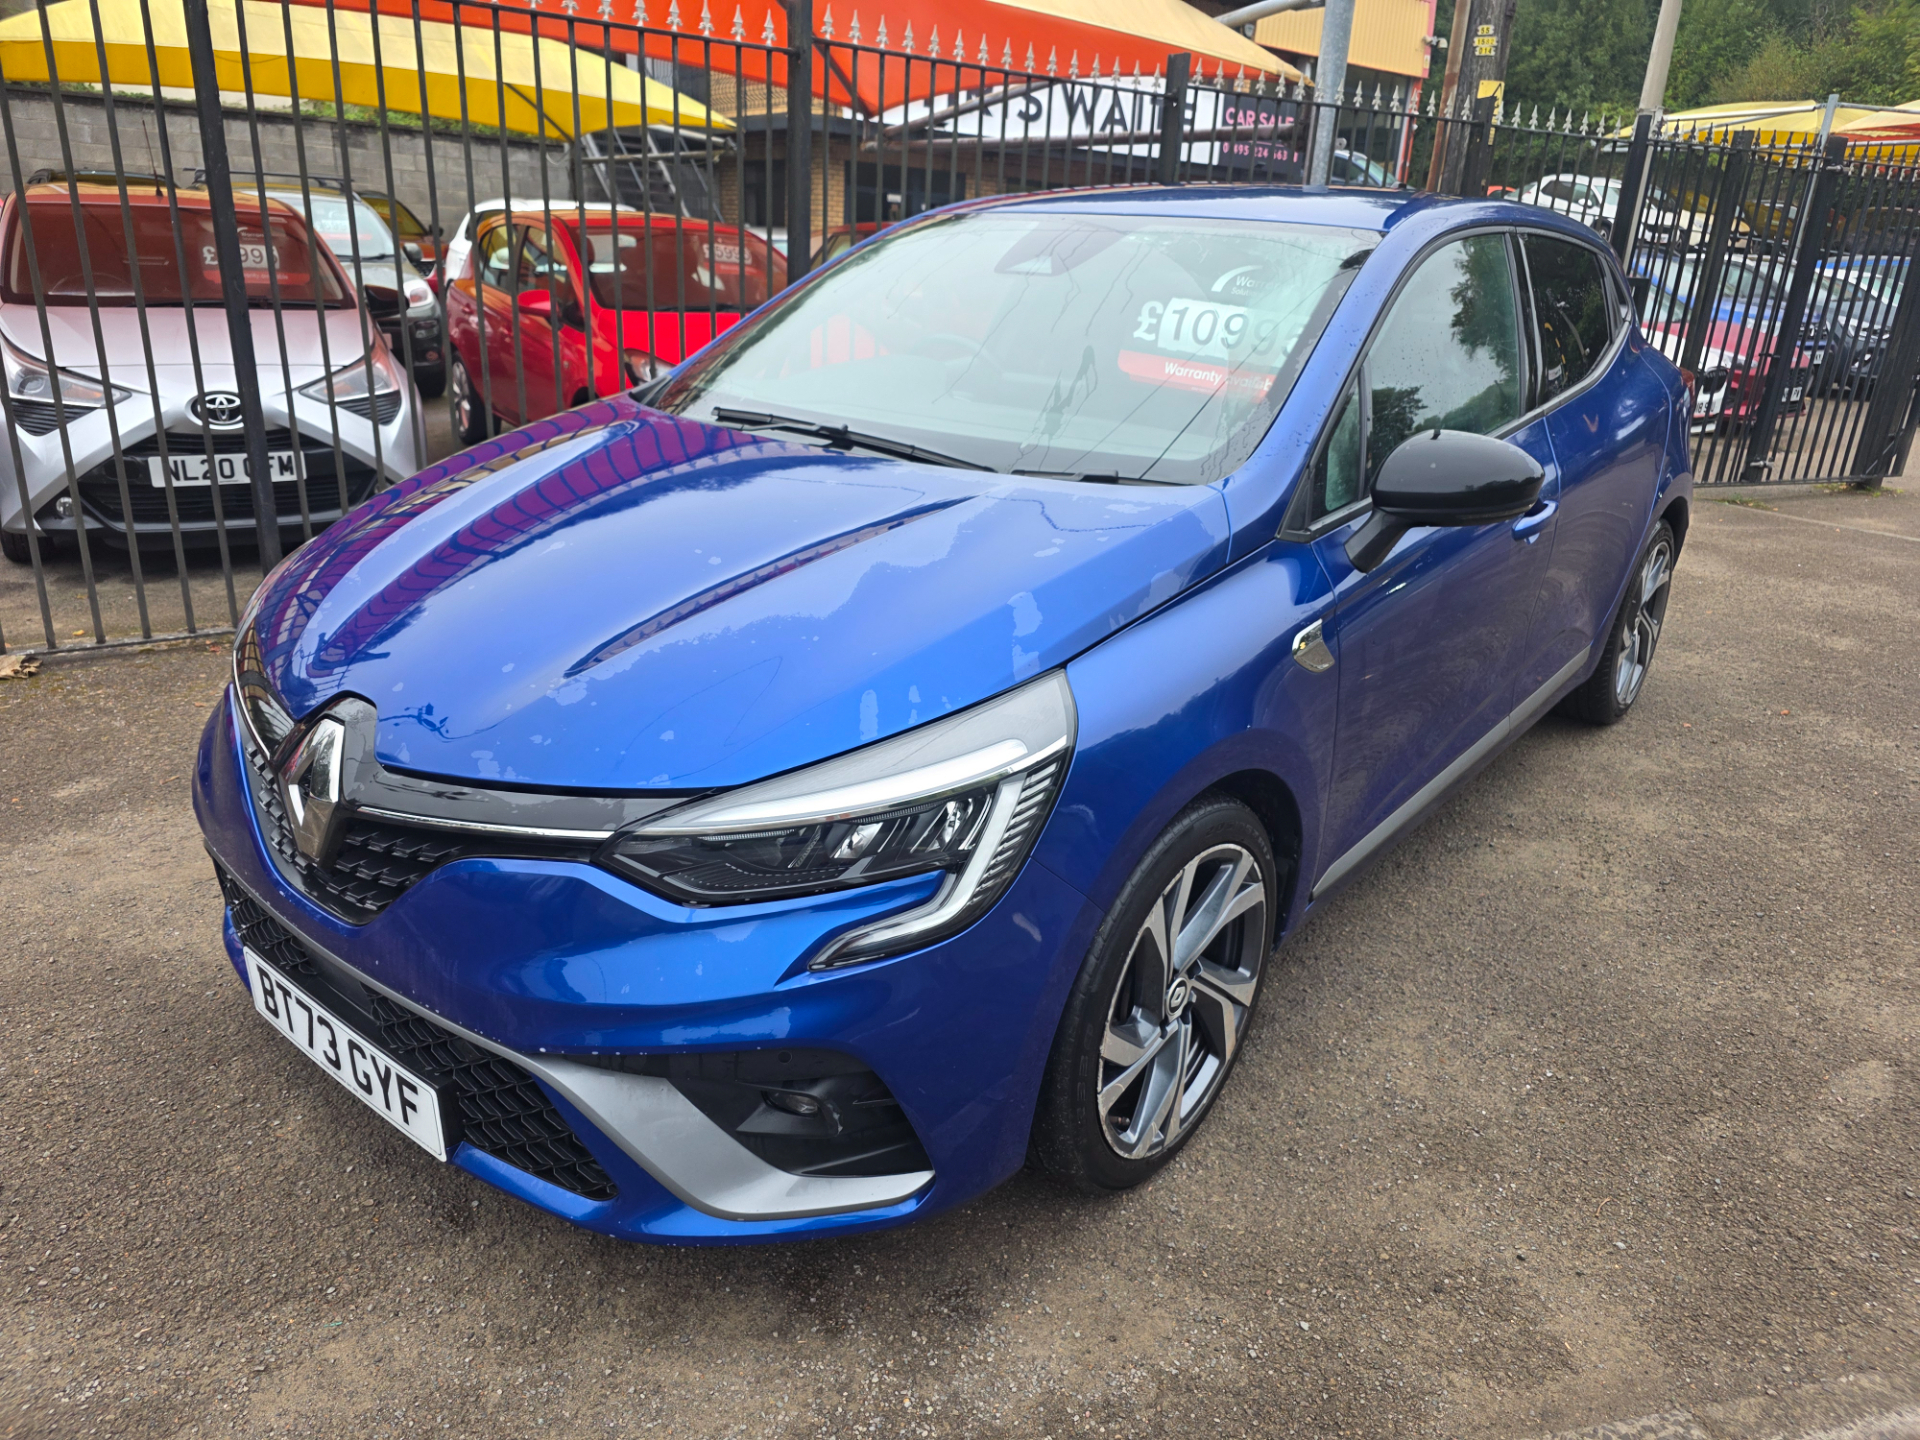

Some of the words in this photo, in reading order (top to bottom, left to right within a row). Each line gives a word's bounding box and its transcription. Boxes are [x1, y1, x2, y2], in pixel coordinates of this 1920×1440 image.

[1226, 107, 1256, 127] CAR
[203, 246, 278, 265] £99
[1165, 361, 1223, 386] Warranty
[170, 457, 235, 482] NL20
[256, 963, 342, 1071] BT73
[347, 1038, 419, 1126] GYF
